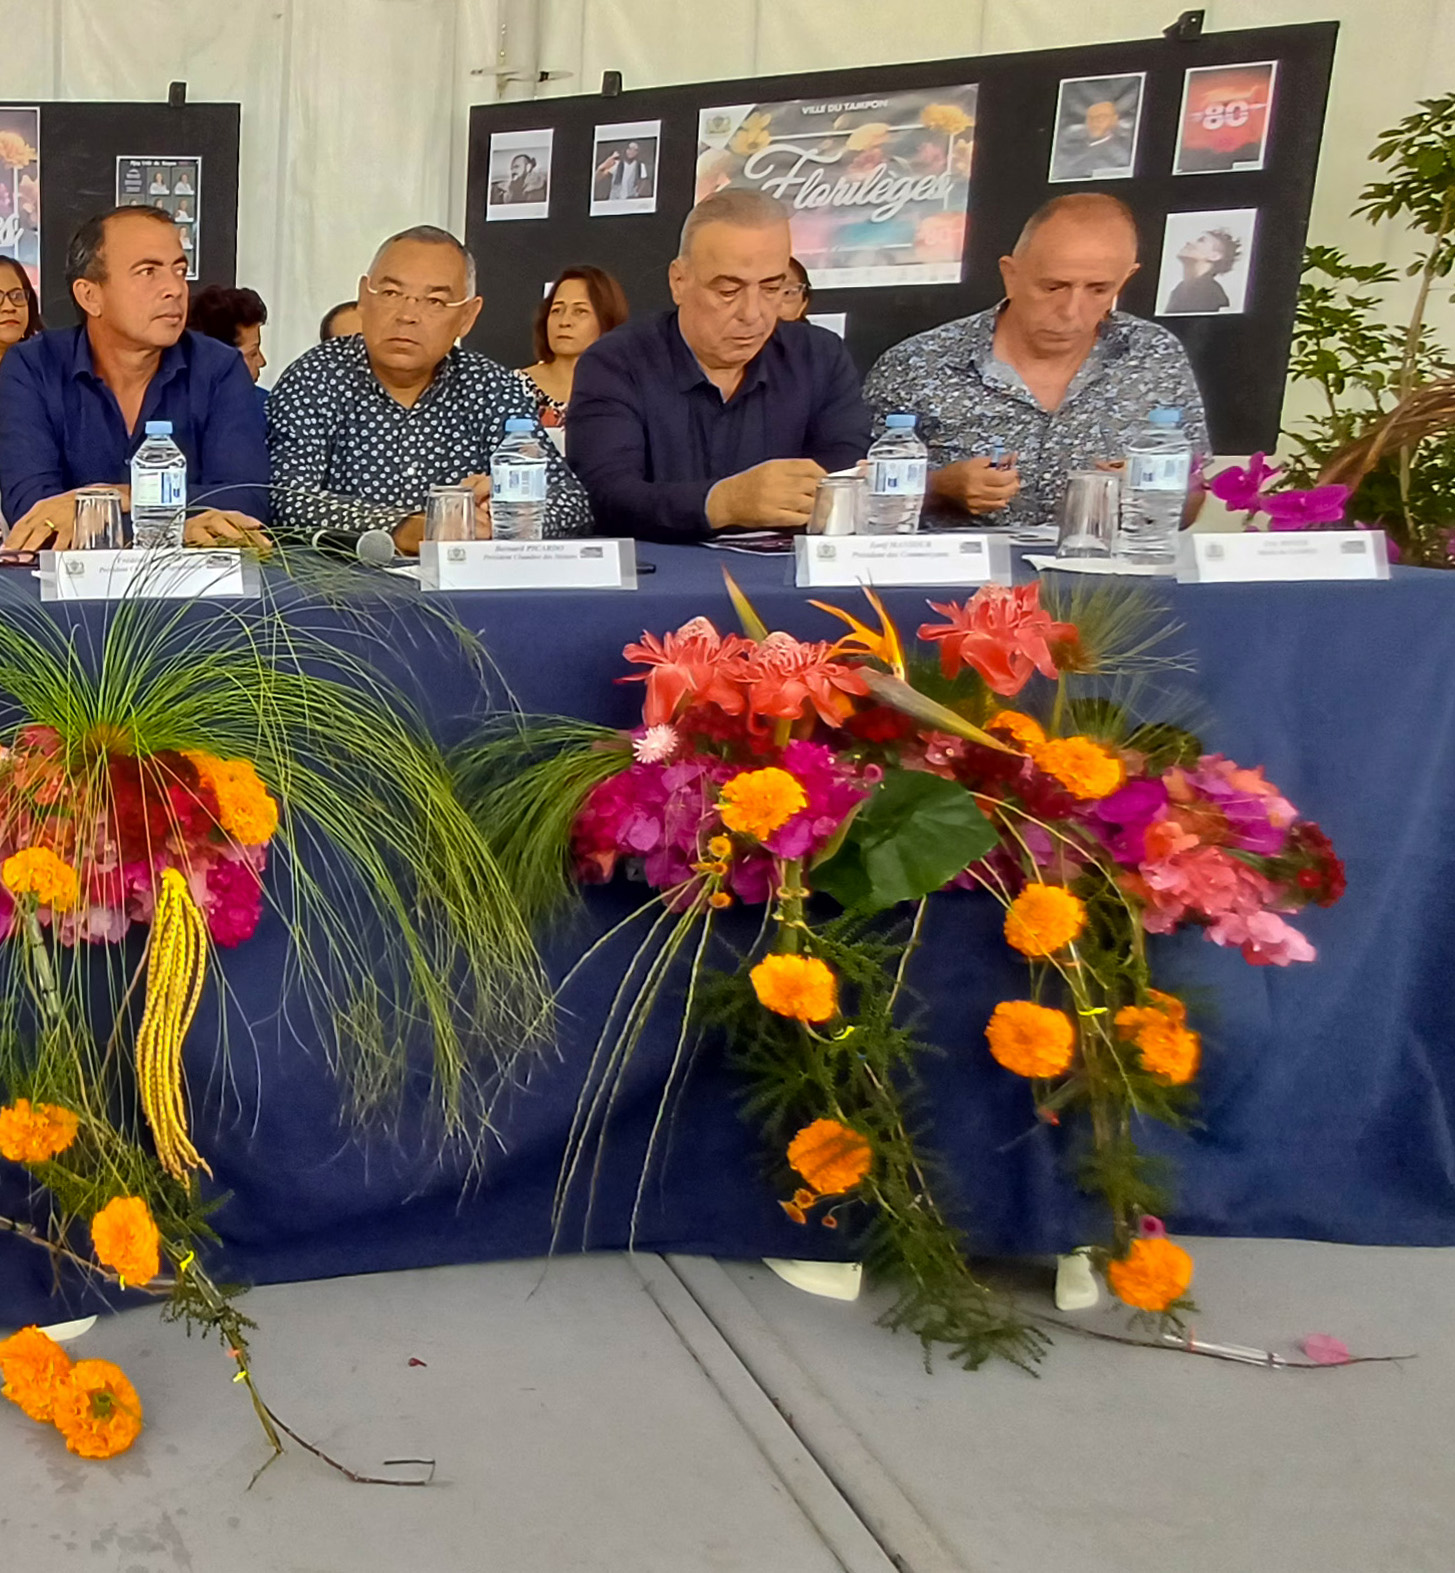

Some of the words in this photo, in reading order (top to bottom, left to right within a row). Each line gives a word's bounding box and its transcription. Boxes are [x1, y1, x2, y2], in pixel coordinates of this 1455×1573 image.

[802, 104, 826, 115] VILLE
[827, 102, 842, 112] DU
[844, 99, 888, 111] TAMPON
[1202, 100, 1248, 130] 80
[744, 143, 955, 223] Florilèges
